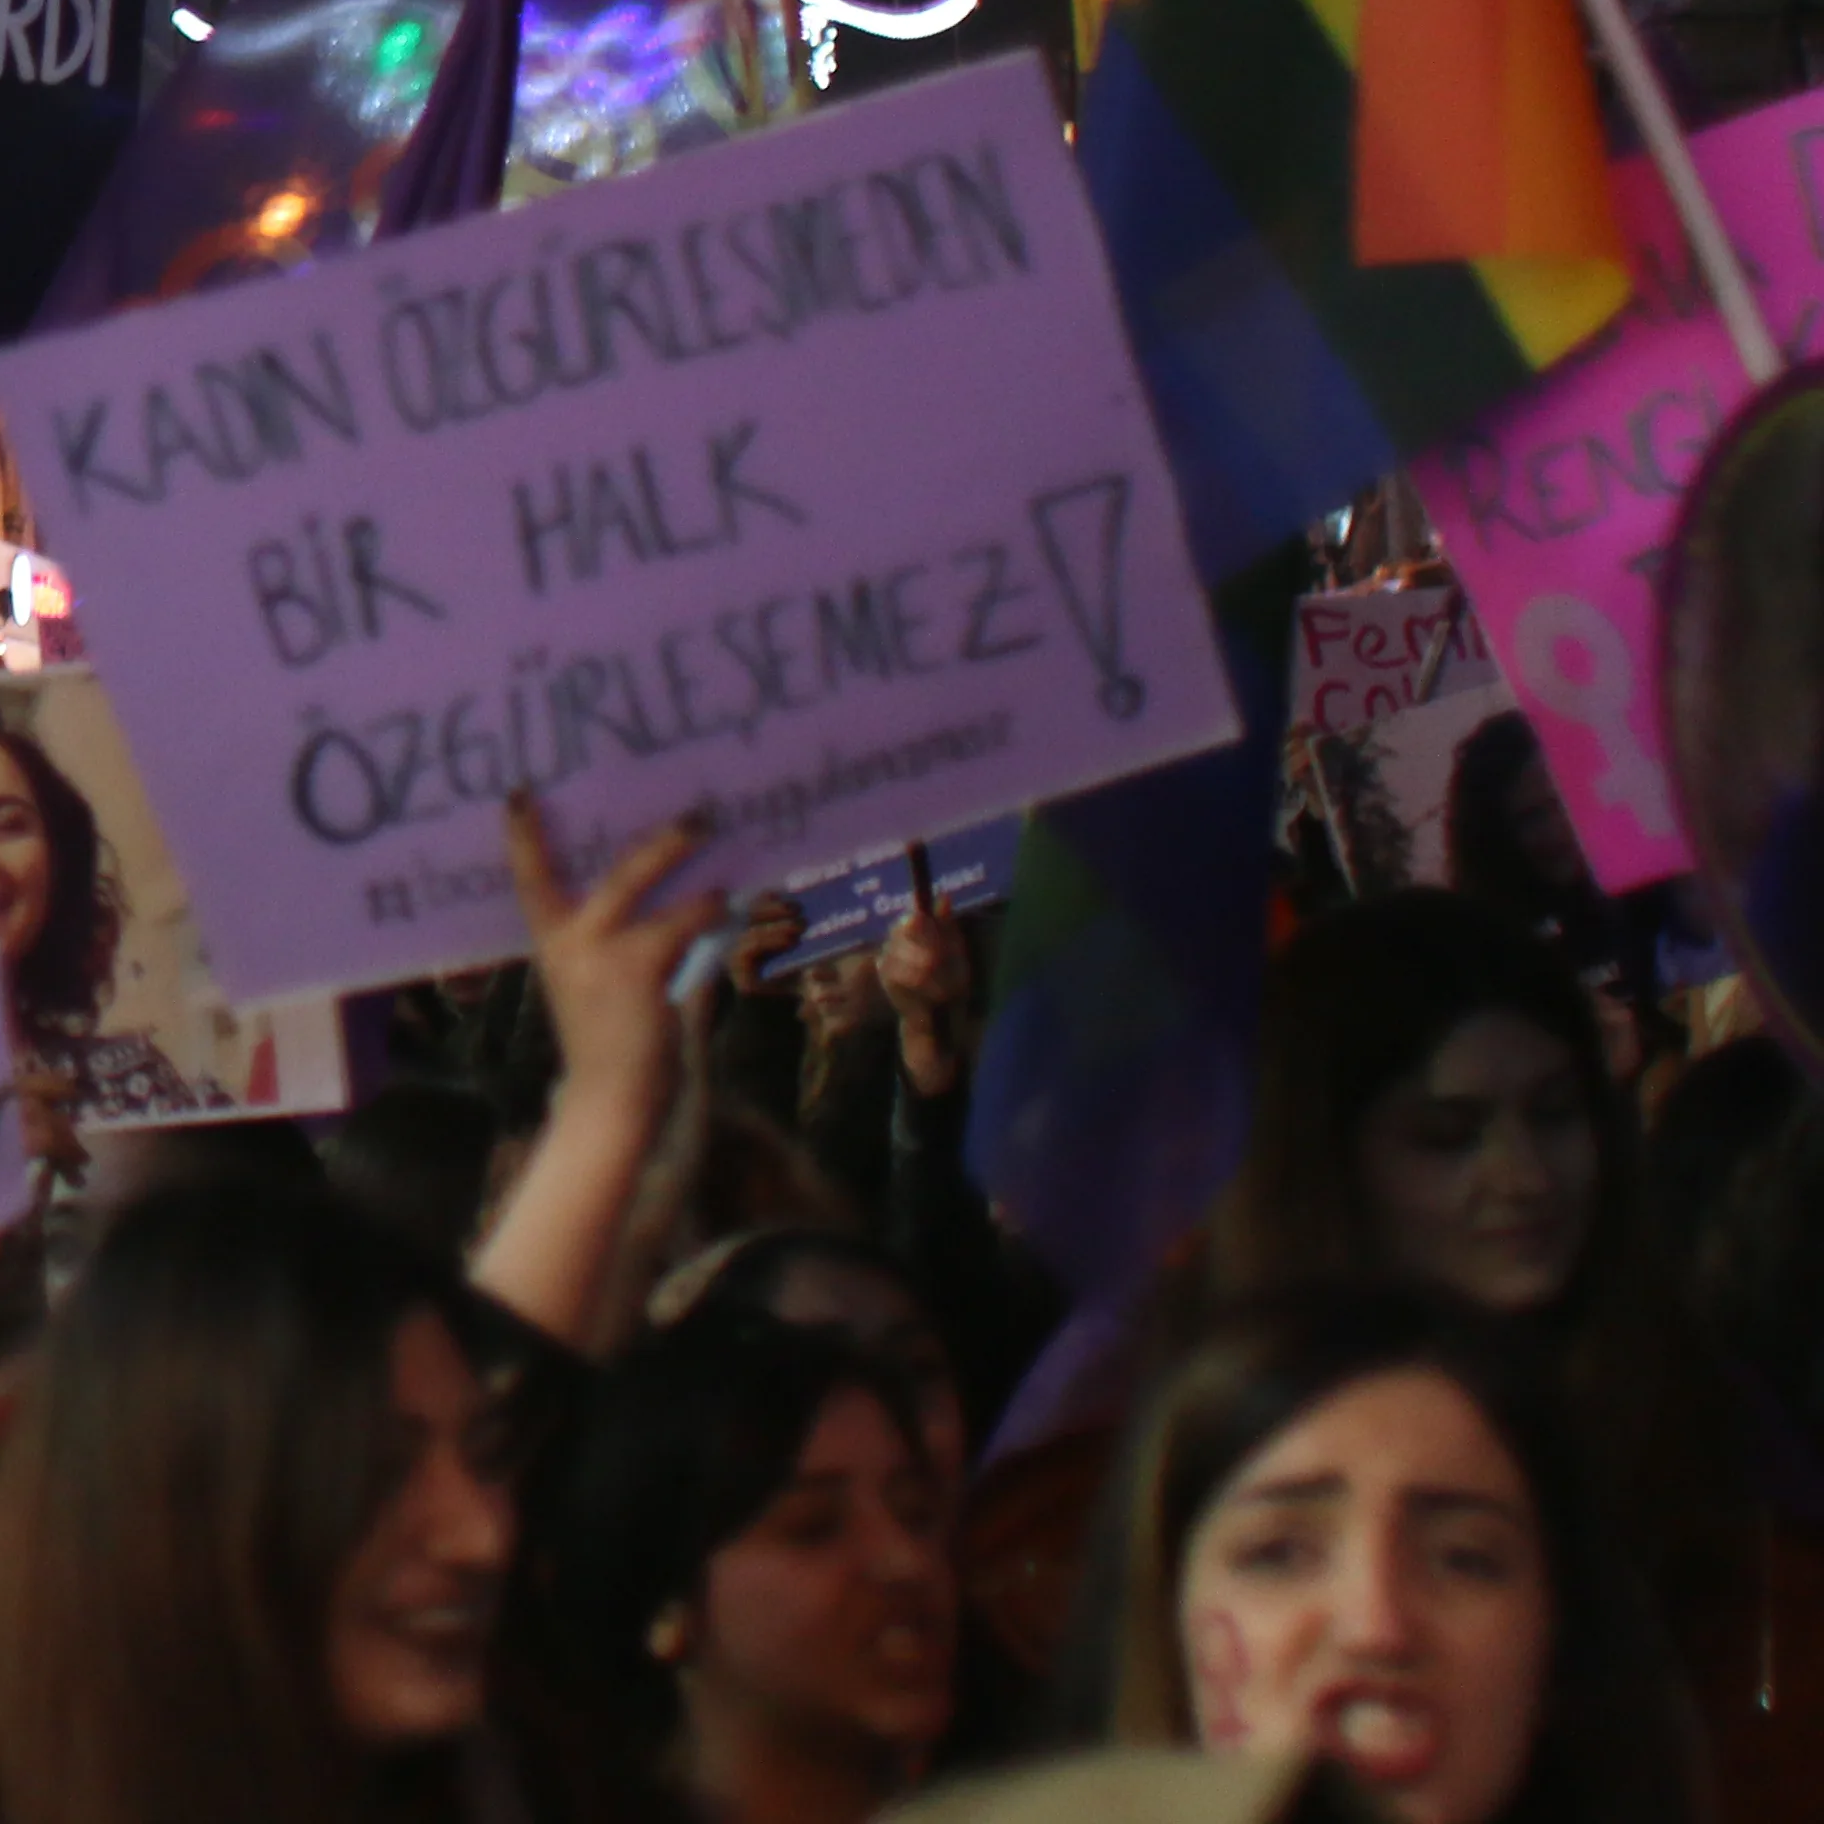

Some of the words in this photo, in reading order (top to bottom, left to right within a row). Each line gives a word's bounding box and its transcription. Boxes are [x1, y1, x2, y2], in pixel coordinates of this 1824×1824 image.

[57, 326, 363, 515] KADIN
[247, 503, 447, 671] BİR
[514, 420, 807, 594] HALK
